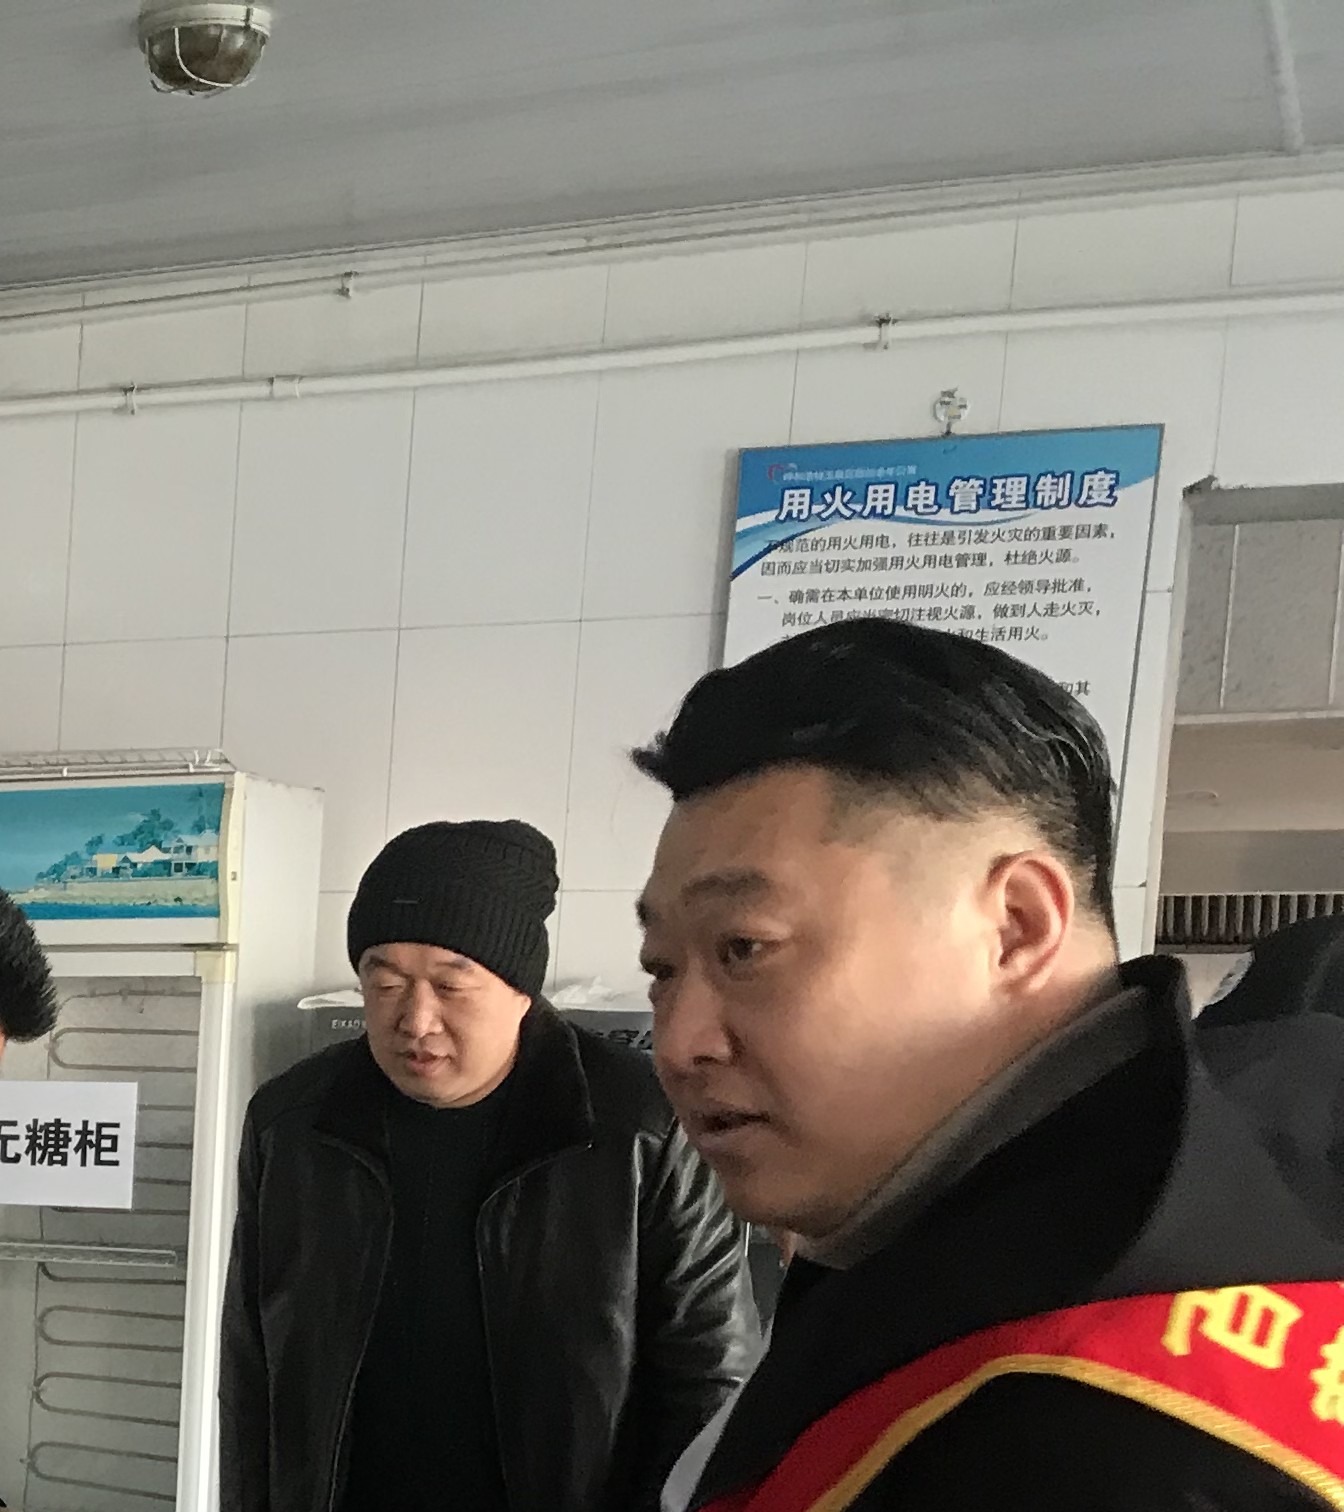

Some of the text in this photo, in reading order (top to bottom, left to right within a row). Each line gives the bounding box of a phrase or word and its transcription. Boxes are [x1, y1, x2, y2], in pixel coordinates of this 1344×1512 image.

[776, 468, 1119, 522] 用火用电管理制度
